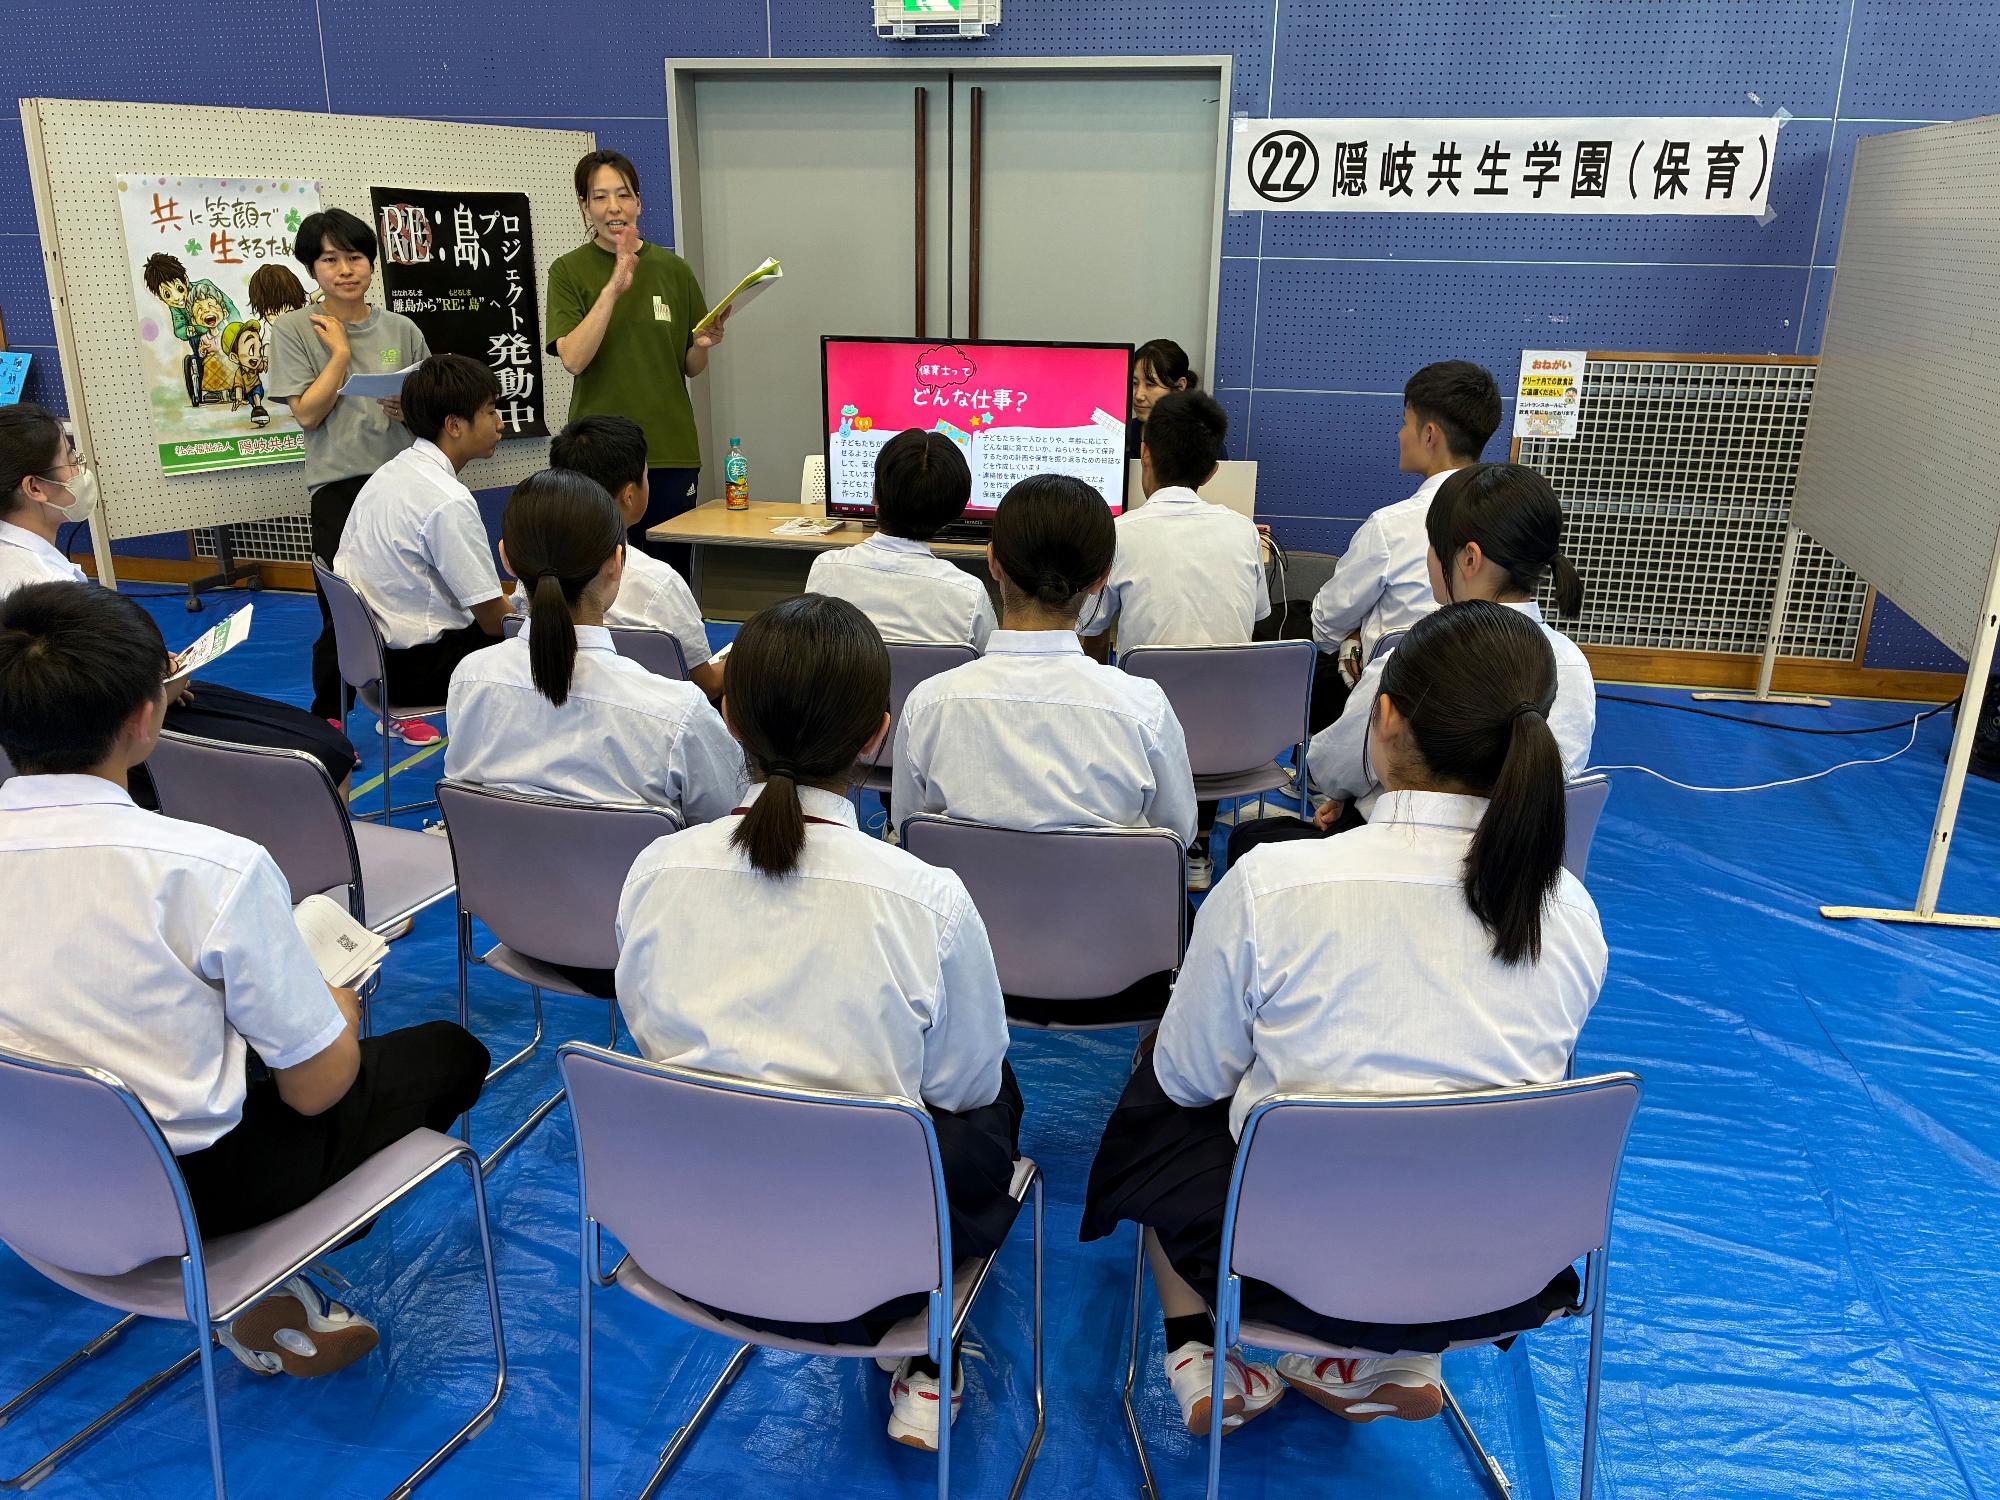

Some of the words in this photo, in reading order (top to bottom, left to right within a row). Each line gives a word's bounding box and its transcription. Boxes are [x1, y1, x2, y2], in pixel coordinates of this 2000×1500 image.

[150, 192, 279, 234] 共に笑顔で
[391, 289, 424, 297] はなれるしま
[448, 288, 472, 297] もどるしま
[918, 364, 971, 376] 保育士って
[1531, 358, 1573, 371] おねがい
[912, 388, 1028, 412] どんな仕事？
[840, 439, 887, 448] 子どもたちが
